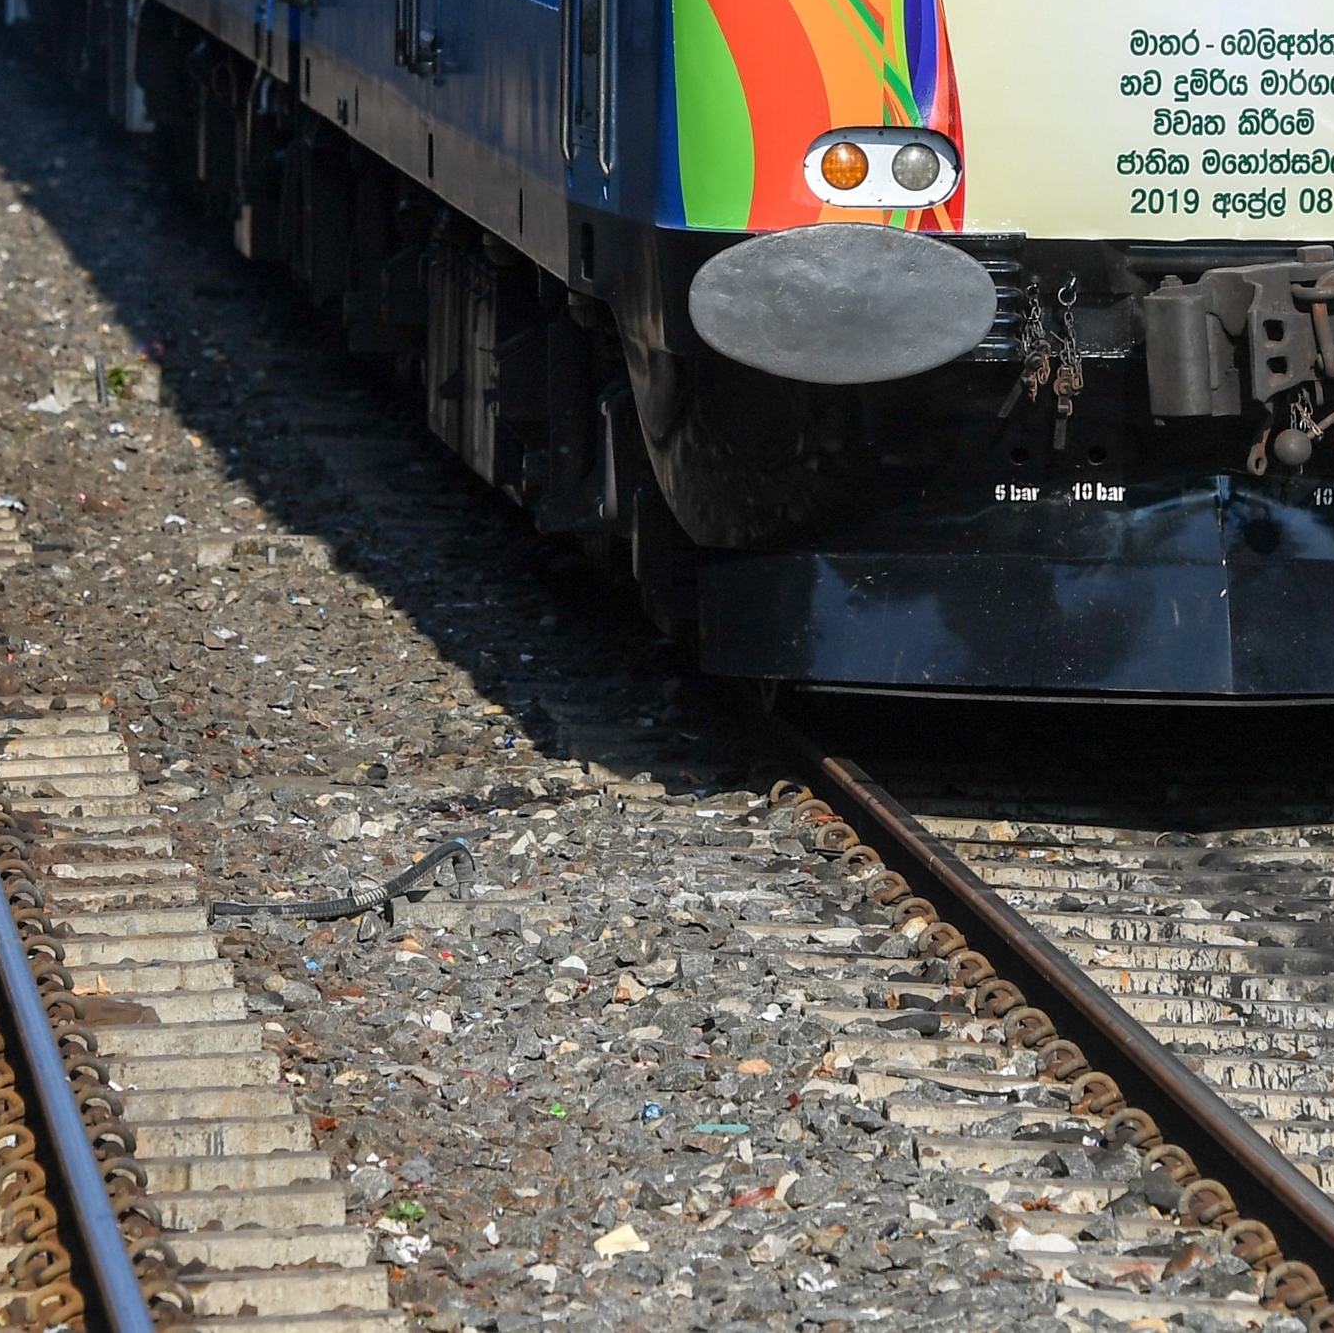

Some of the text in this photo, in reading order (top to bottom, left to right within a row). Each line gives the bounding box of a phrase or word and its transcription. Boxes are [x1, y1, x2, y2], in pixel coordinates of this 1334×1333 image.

[1130, 28, 1200, 56] මාතර
[1120, 69, 1162, 96] නව
[1174, 68, 1248, 102] දුම්රිය
[1153, 108, 1315, 136] විවෘත කිරීමේ
[1116, 148, 1190, 175] ජාතික
[1130, 188, 1199, 214] 2019
[1299, 188, 1333, 214] 08
[1009, 483, 1040, 502] bar
[1071, 482, 1127, 502] 10 bar
[1313, 487, 1333, 506] 10
